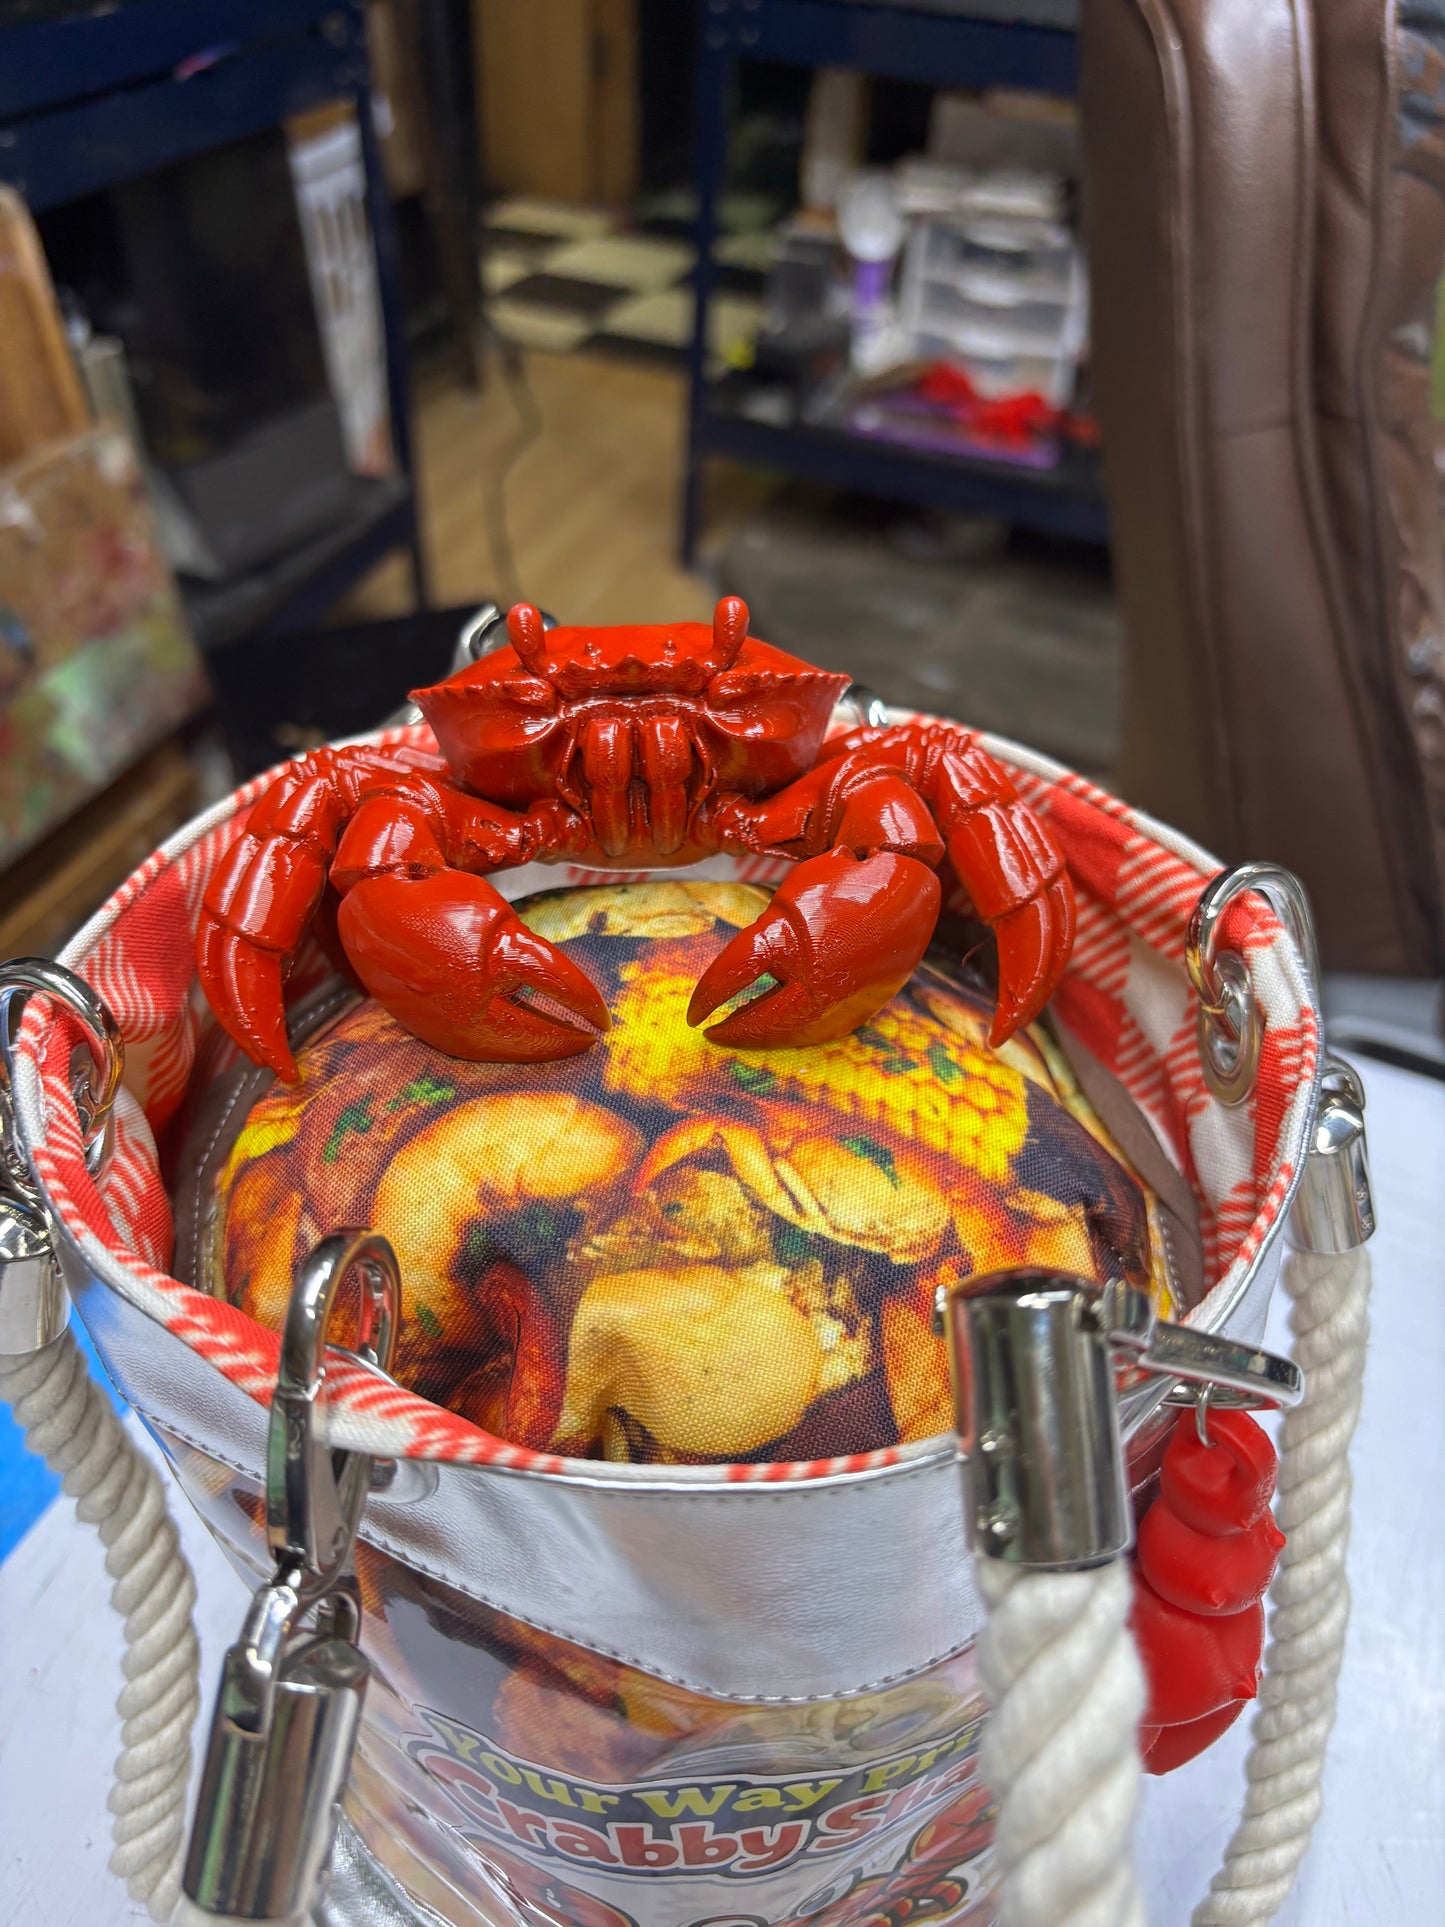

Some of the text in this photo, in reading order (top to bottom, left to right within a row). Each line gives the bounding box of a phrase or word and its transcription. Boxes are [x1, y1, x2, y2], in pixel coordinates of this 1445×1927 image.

[424, 1755, 984, 1869] Crabby Sha
[430, 1718, 981, 1818] Your Way Pri
